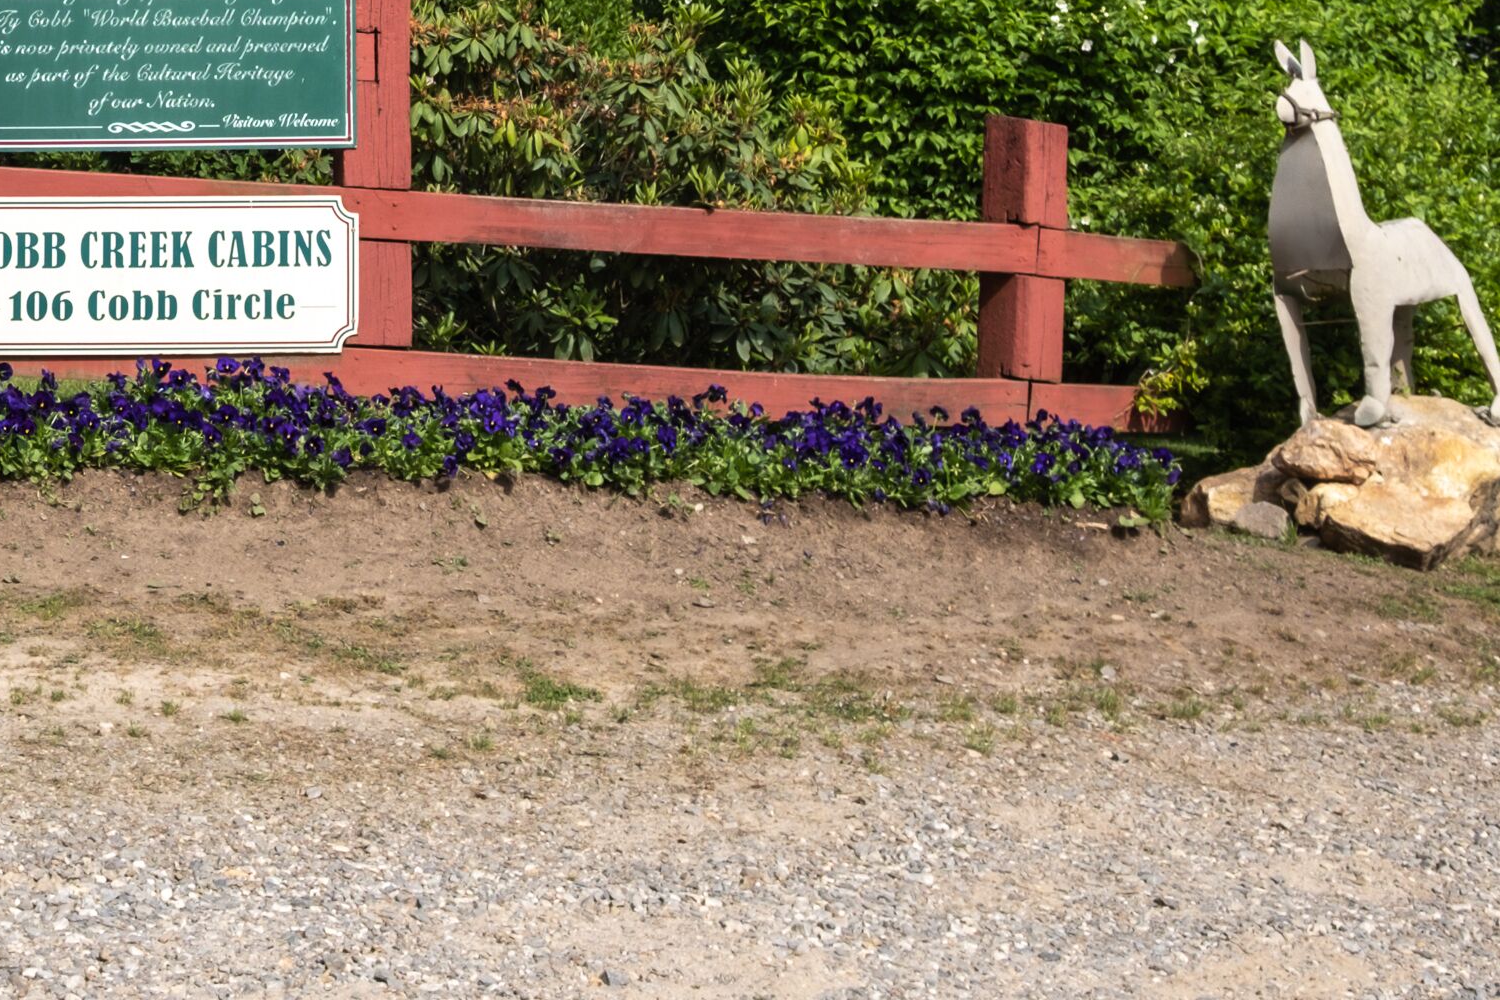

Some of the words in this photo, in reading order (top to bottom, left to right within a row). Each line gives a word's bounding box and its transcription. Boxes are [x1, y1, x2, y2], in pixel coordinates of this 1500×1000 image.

[28, 10, 73, 27] Cobb
[153, 9, 235, 26] Baseball
[15, 43, 53, 55] now
[54, 37, 140, 61] privately
[144, 36, 203, 53] owned
[206, 36, 242, 53] and
[239, 35, 330, 60] preserved
[5, 71, 26, 82] as
[25, 68, 70, 89] part
[73, 64, 99, 88] of
[102, 64, 130, 81] the
[137, 63, 212, 81] Cultural
[88, 92, 113, 116] of
[111, 99, 144, 109] our
[146, 91, 215, 109] Nation.
[222, 113, 275, 128] Visitors
[278, 113, 340, 128] Welcome
[80, 231, 194, 268] CREEK
[208, 229, 332, 268] CABINS
[9, 290, 73, 321] 106
[88, 289, 178, 320] Cobb
[192, 289, 295, 320] Circle
